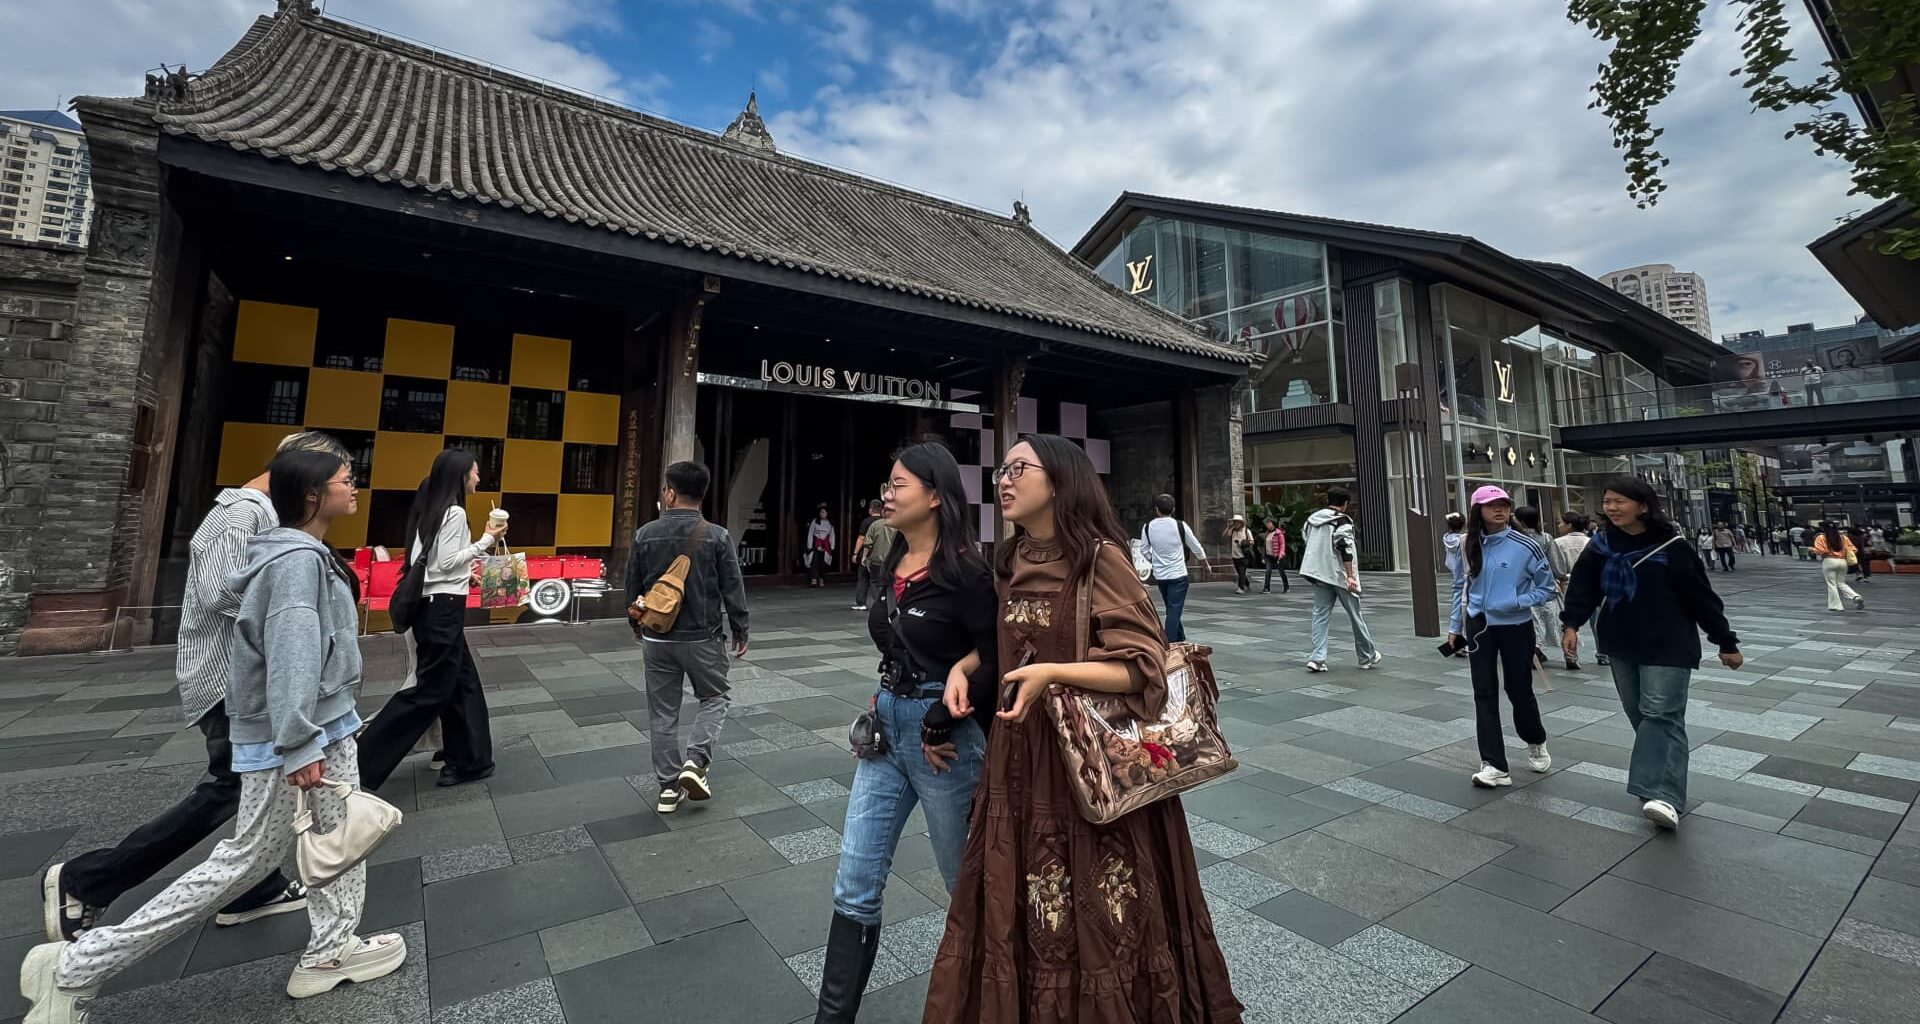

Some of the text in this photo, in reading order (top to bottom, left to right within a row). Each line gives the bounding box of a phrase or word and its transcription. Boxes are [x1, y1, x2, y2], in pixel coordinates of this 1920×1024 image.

[1126, 255, 1153, 294] LV
[761, 359, 941, 400] LOUIS VUITTON
[1494, 360, 1514, 403] LV
